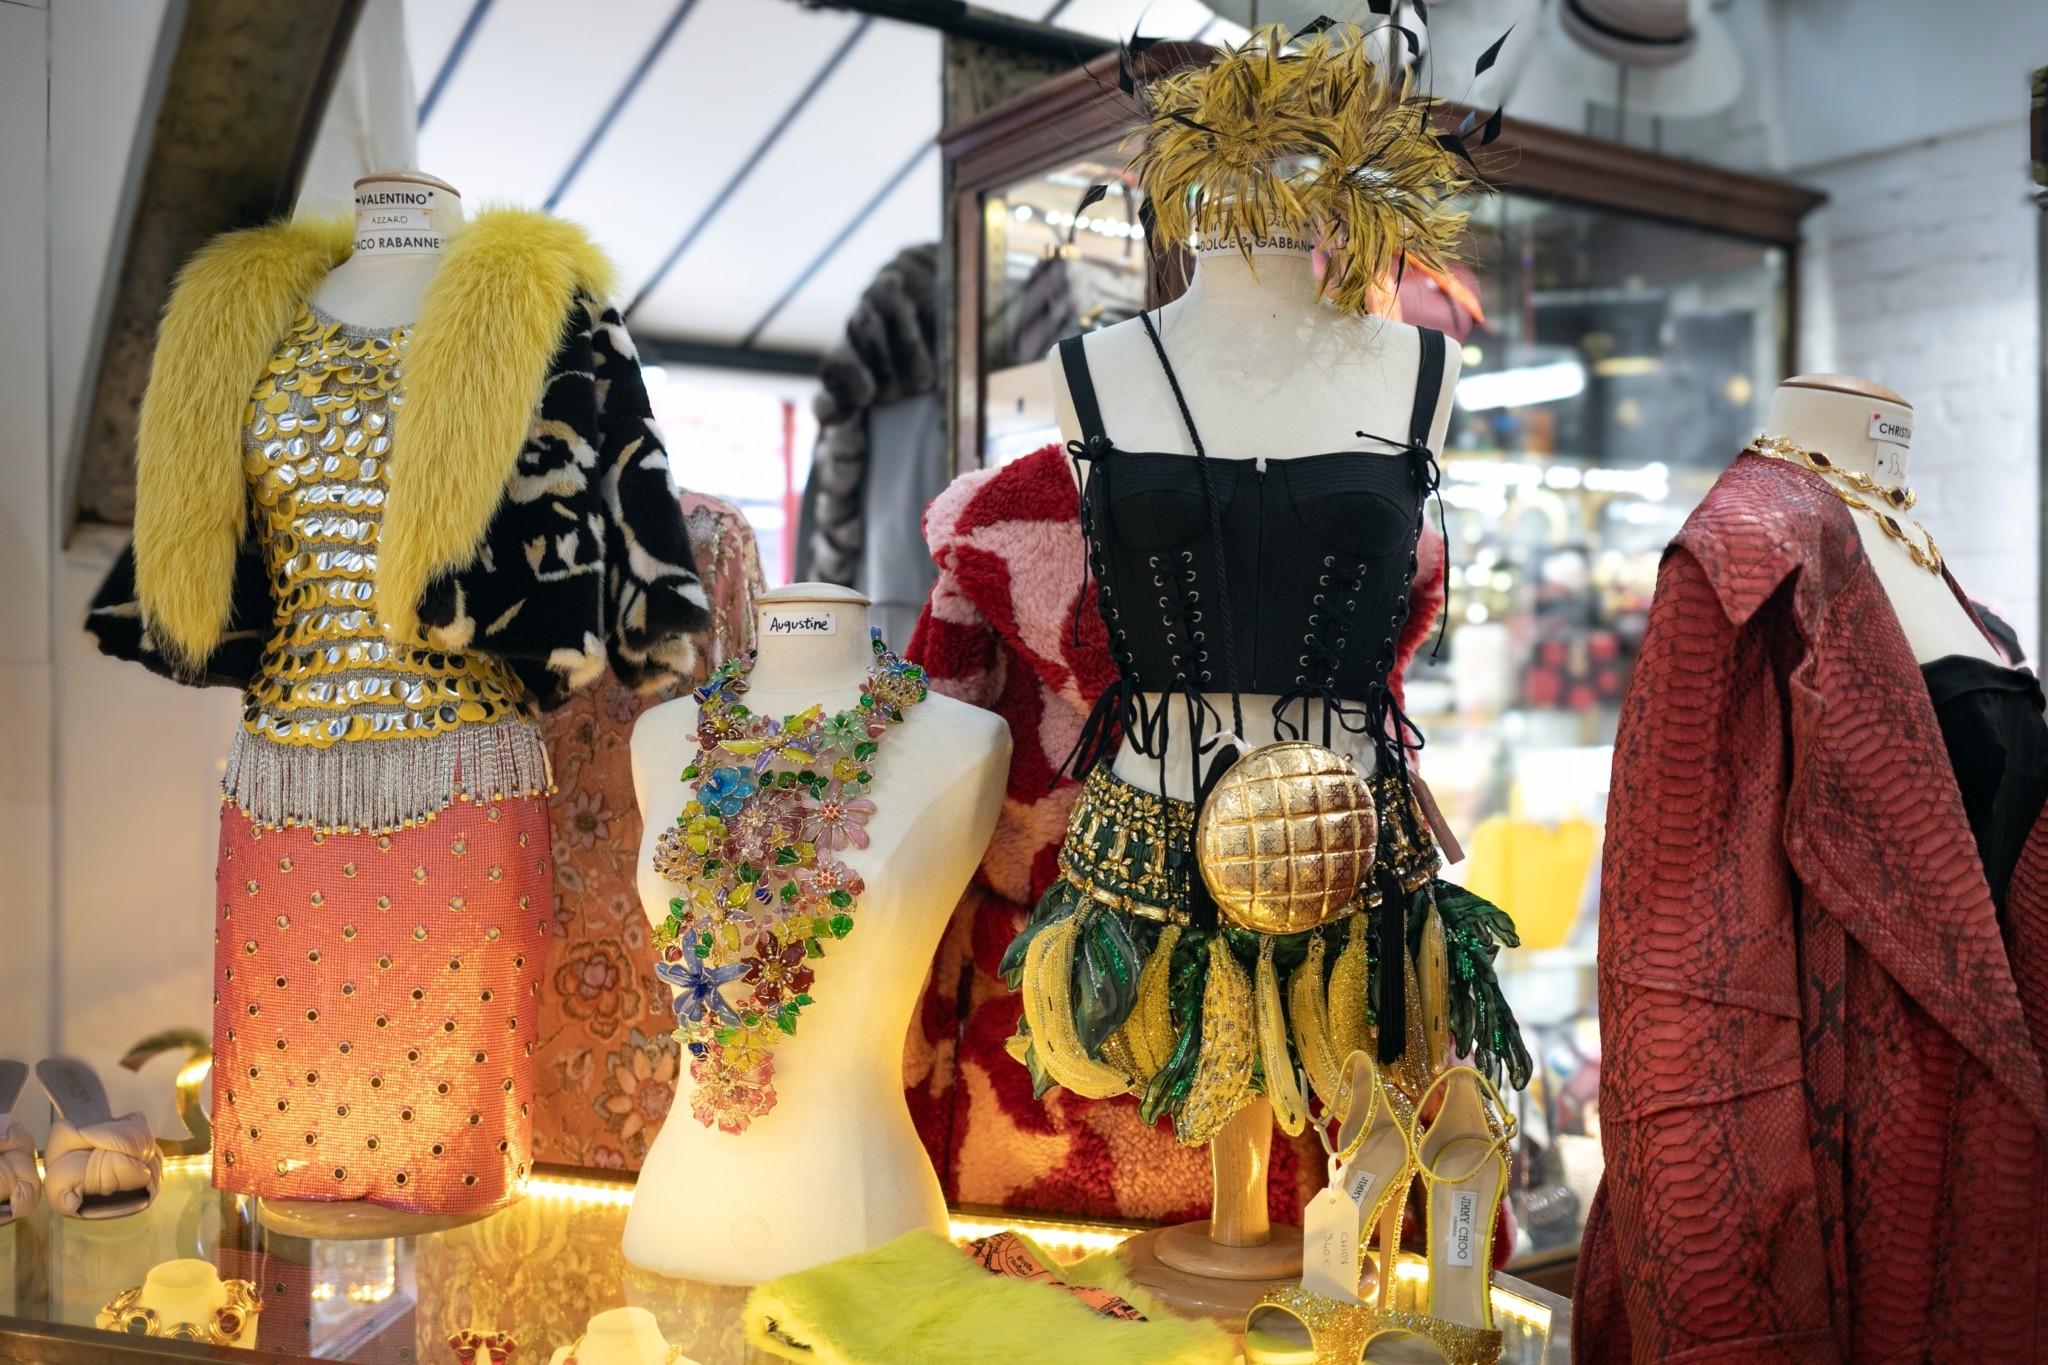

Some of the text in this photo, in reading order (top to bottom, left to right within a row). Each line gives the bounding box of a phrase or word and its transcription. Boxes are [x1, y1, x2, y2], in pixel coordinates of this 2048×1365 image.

[361, 193, 427, 205] VALENTINO
[372, 215, 408, 225] AZZARO
[355, 237, 440, 251] ACO RABANNE
[769, 617, 829, 633] Augustine
[1351, 1176, 1369, 1202] JIMMY
[1457, 1195, 1472, 1260] JIMMY CHOO
